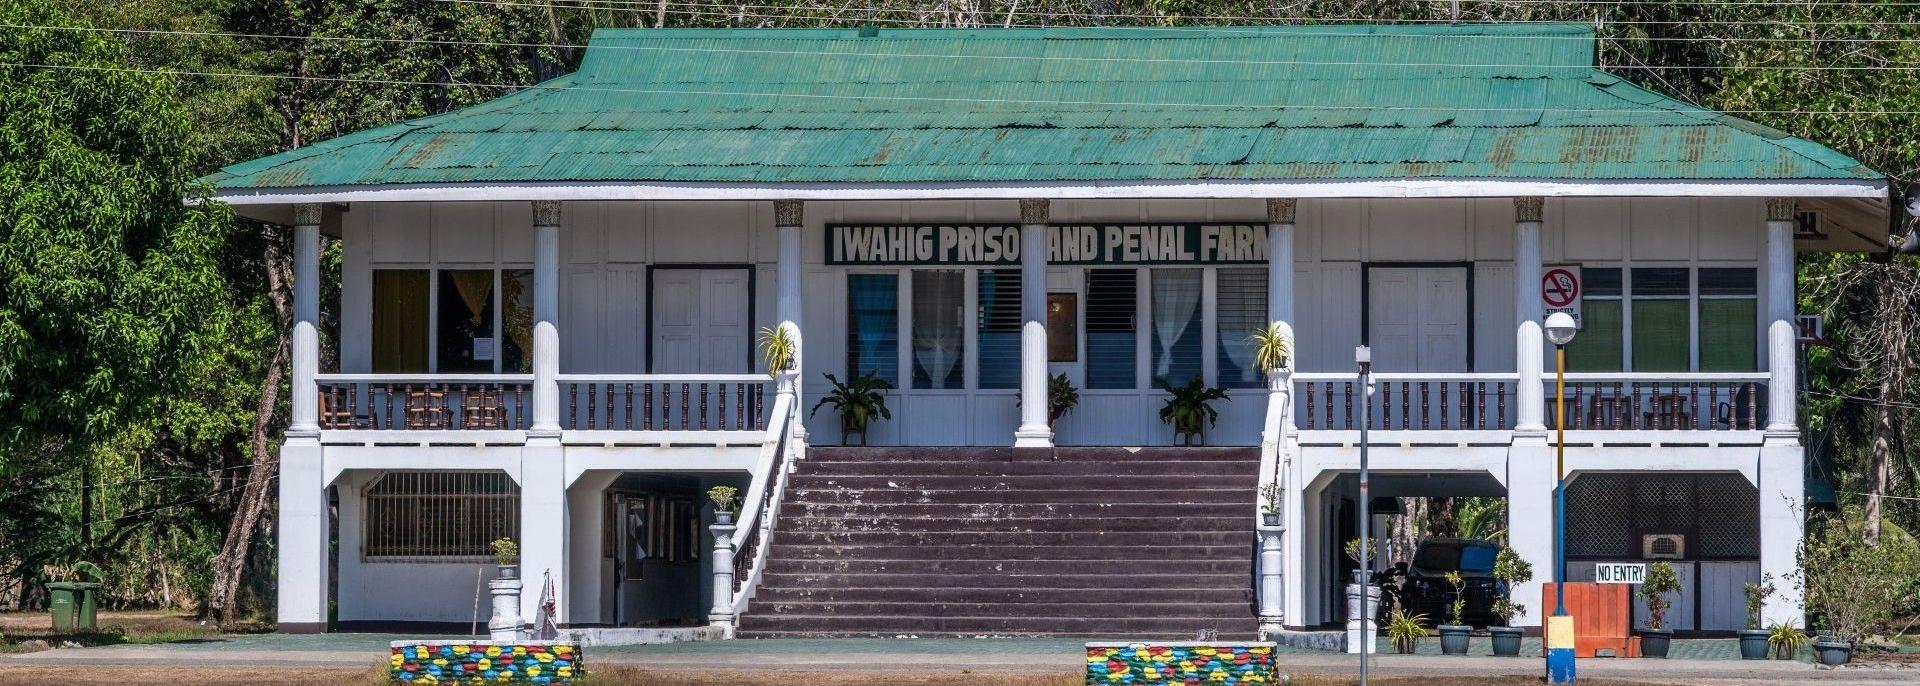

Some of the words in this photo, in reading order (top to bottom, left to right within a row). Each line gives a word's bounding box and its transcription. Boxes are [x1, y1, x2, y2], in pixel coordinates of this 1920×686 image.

[833, 226, 933, 261] IWAHIG
[939, 226, 1020, 261] PRISO
[1047, 226, 1098, 261] AND
[1104, 225, 1194, 261] PENAL
[1598, 565, 1611, 581] NO
[1613, 565, 1644, 581] ENTRY
